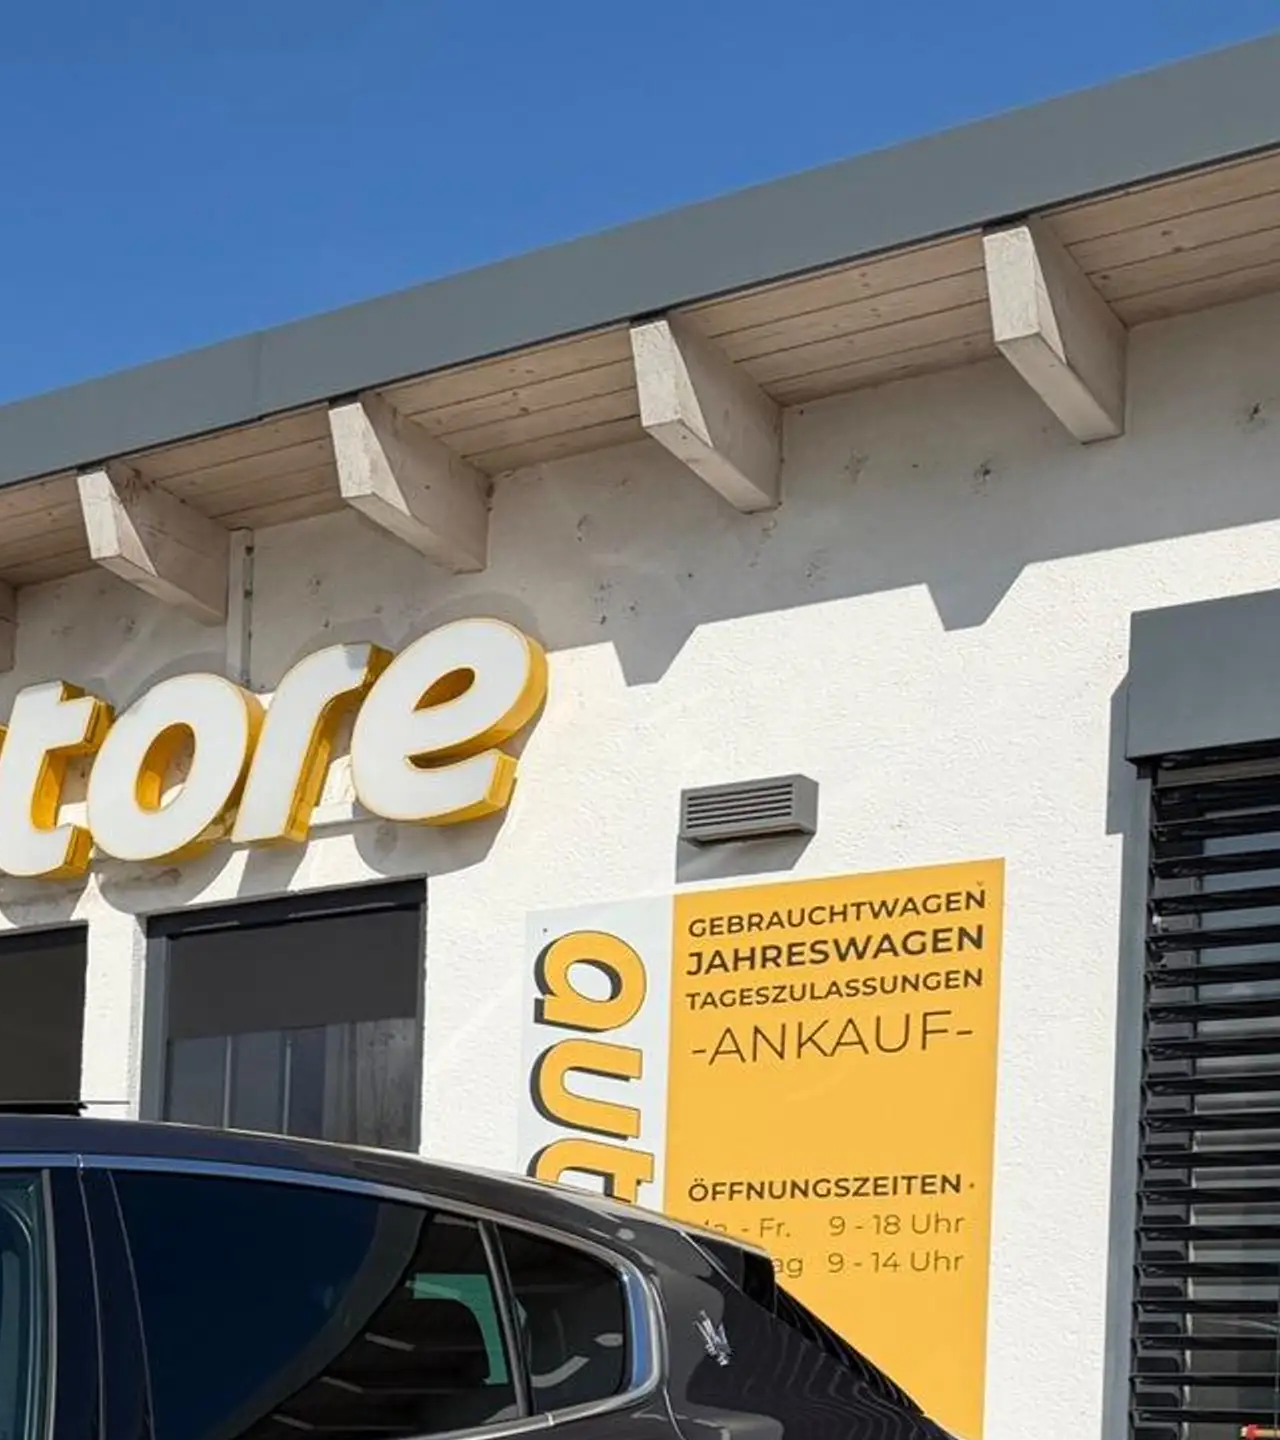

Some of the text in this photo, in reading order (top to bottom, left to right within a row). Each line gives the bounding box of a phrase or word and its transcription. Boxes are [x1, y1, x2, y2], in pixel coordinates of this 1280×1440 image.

[687, 888, 987, 938] GEBRAUCHTWAGEN
[685, 923, 984, 977] JAHRESWAGEN
[685, 967, 983, 1011] TAGESZULASSUNGEN
[690, 1009, 974, 1067] -ANKAUF-
[687, 1173, 962, 1203] ÖFFNUNGSZEITEN
[758, 1216, 791, 1239] Fr.
[828, 1215, 846, 1237] 9
[873, 1213, 901, 1236] 18
[910, 1211, 964, 1236] Uhr
[827, 1252, 845, 1274] 9
[872, 1250, 900, 1274] 14
[909, 1248, 964, 1274] Uhr
